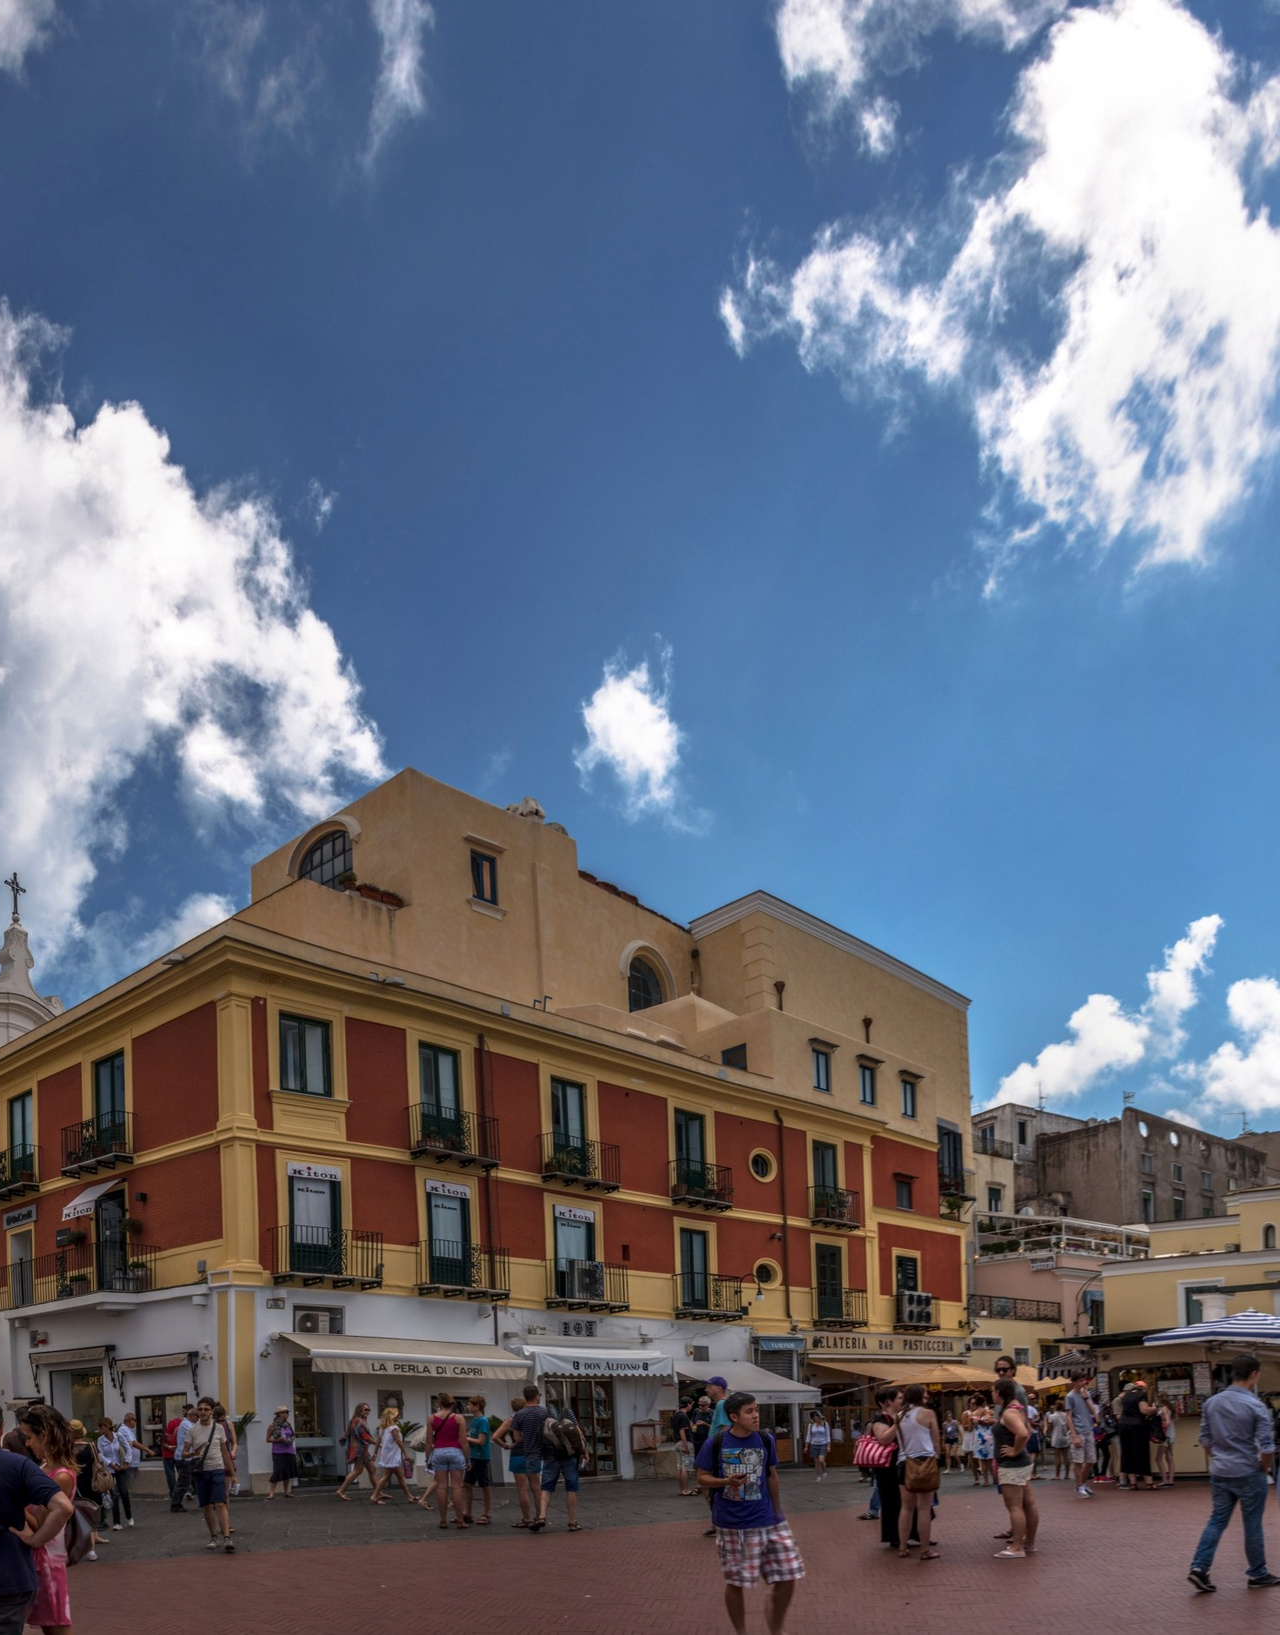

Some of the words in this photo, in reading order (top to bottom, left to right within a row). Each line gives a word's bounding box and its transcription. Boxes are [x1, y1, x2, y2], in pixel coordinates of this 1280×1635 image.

[291, 1166, 338, 1180] Kiton
[296, 1187, 326, 1195] Kiton
[429, 1183, 468, 1198] Kiton
[64, 1206, 92, 1219] Kiton
[558, 1209, 592, 1222] Kiton
[879, 1339, 894, 1350] BAR
[903, 1339, 954, 1352] PASTICCERIA
[371, 1363, 387, 1372] LA
[393, 1363, 431, 1374] PERLA
[436, 1366, 447, 1375] DI
[453, 1366, 483, 1376] CAPRI
[584, 1362, 601, 1371] DON
